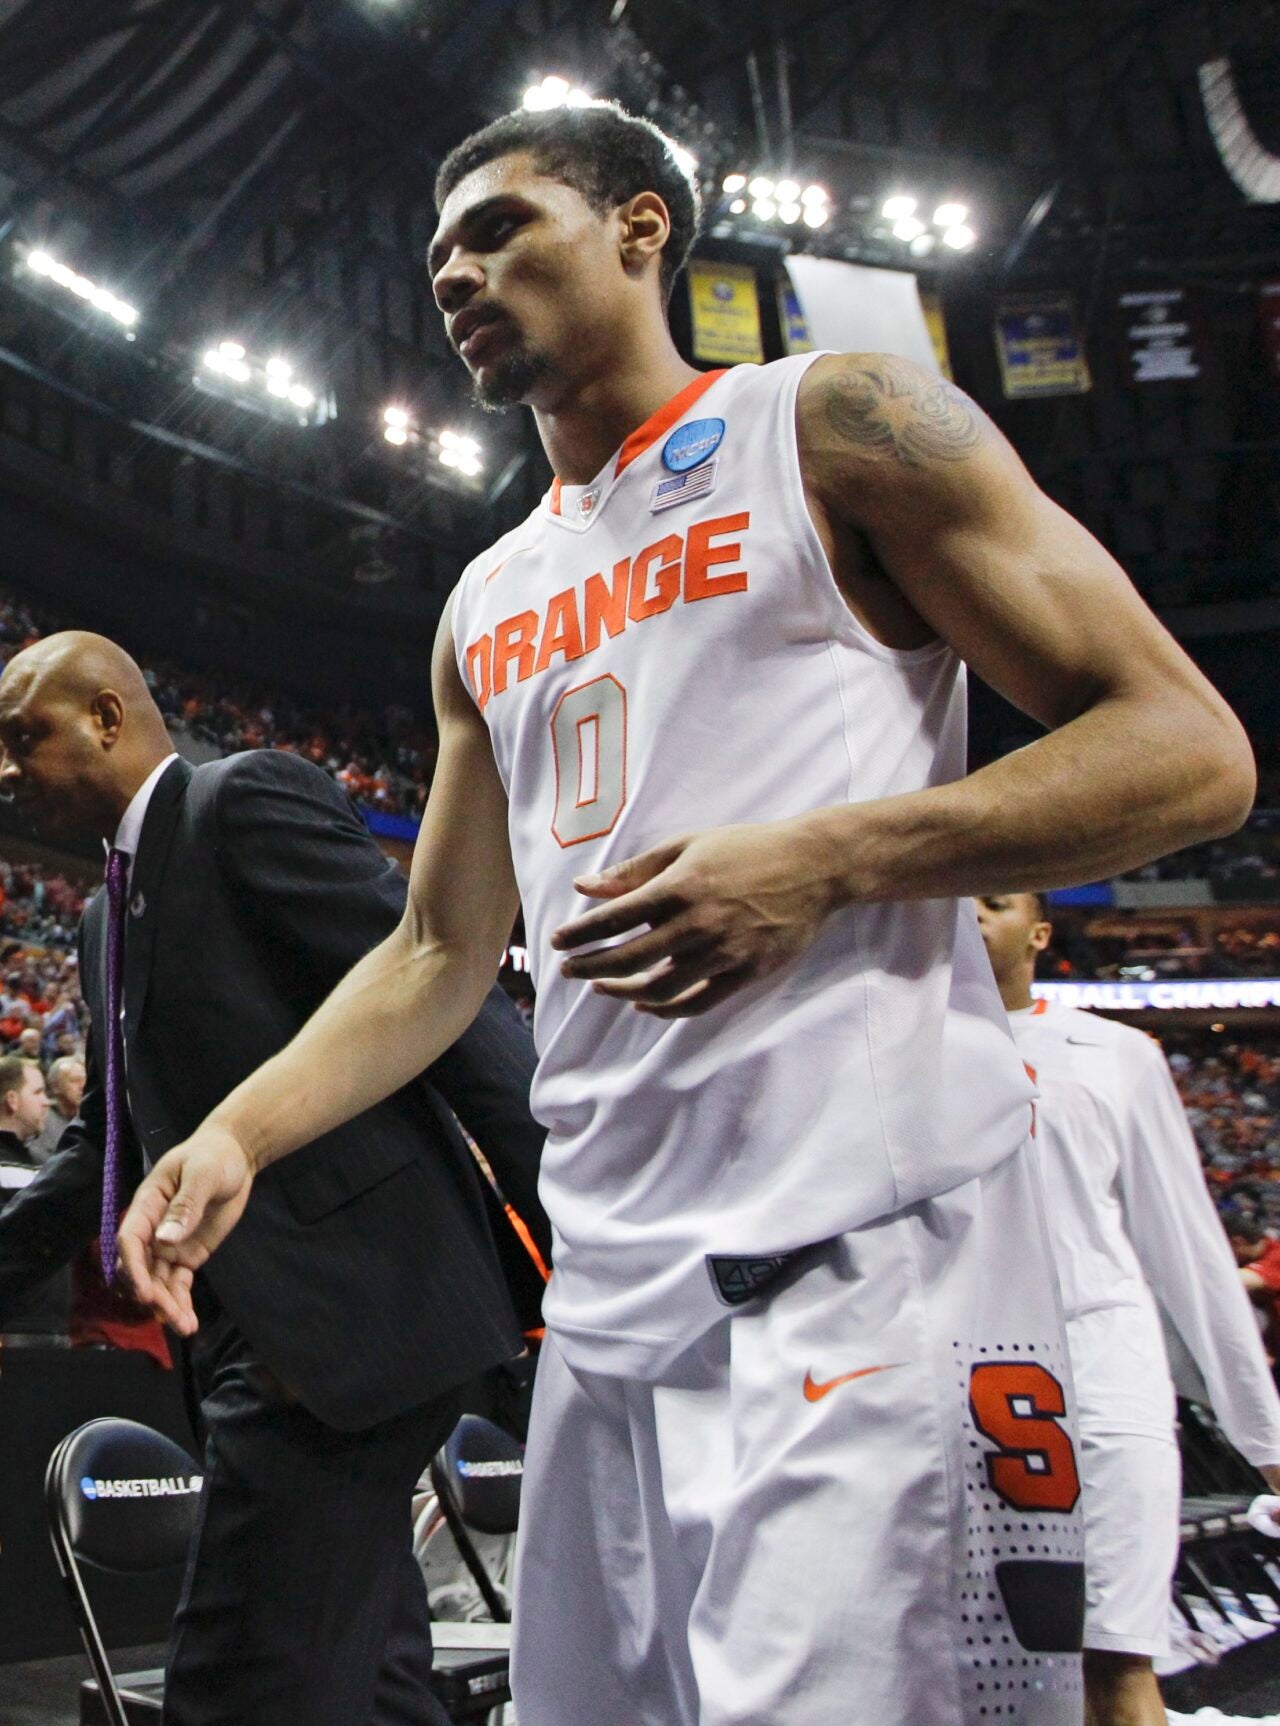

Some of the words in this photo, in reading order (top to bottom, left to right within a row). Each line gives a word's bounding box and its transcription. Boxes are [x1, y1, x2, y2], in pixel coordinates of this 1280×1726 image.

[466, 511, 750, 714] ORANGE
[550, 672, 628, 848] 0
[95, 1476, 191, 1498] BASKETBALL
[968, 1361, 1081, 1513] S
